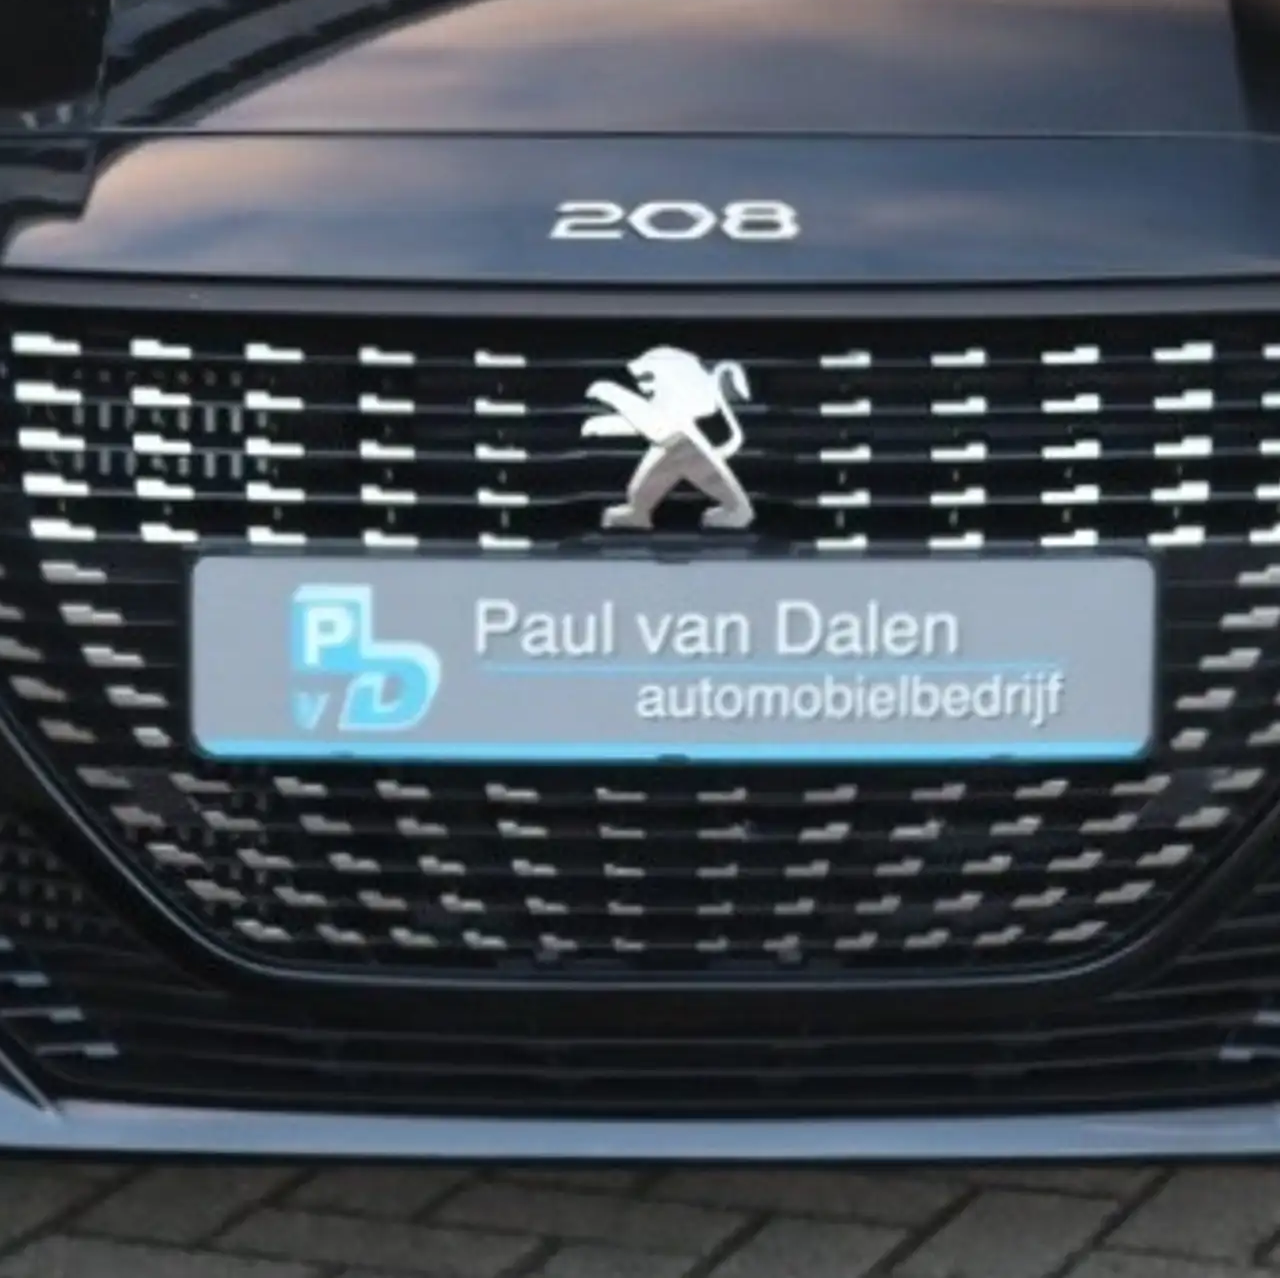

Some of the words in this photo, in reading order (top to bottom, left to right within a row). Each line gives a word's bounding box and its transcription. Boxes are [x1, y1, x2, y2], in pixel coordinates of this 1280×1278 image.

[549, 199, 801, 240] 208
[474, 599, 614, 656] Paul
[636, 609, 751, 656] van
[776, 599, 959, 656] Dalen
[635, 669, 1065, 727] automobielbedrijf
